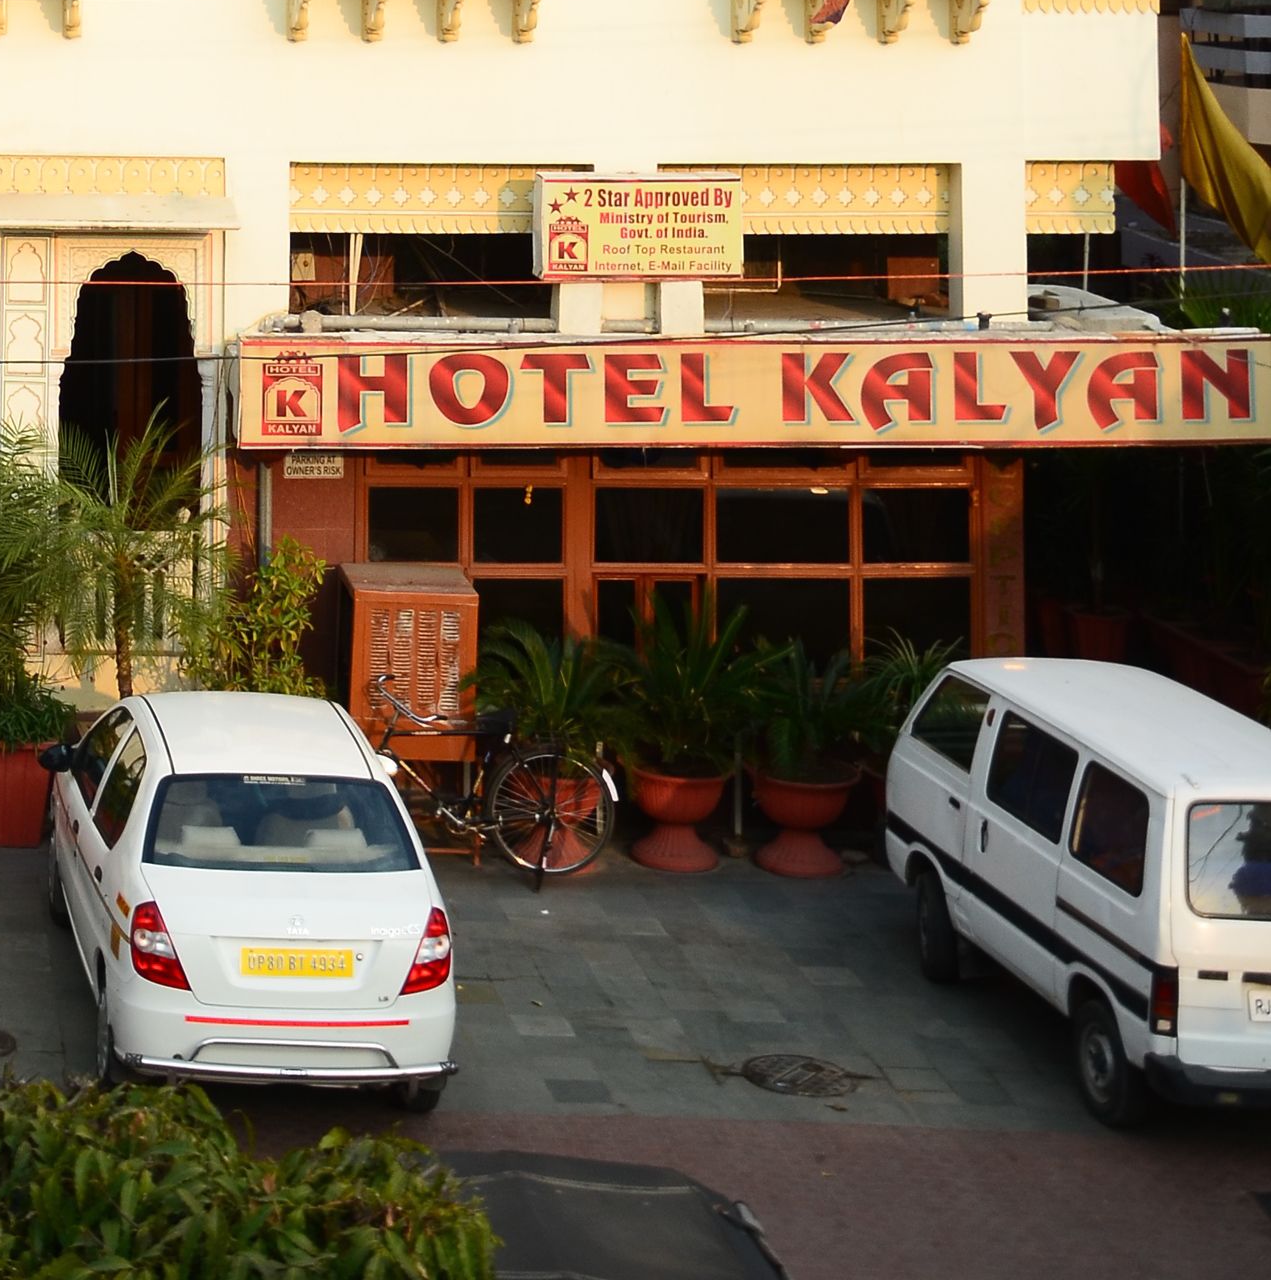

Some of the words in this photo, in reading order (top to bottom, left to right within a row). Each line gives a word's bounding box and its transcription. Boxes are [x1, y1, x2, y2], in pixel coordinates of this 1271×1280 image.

[583, 188, 593, 207] 2
[597, 188, 630, 207] Star
[634, 187, 709, 209] Approved
[713, 187, 732, 208] By
[599, 211, 653, 224] Ministry
[656, 211, 669, 223] of
[672, 211, 729, 224] Tourism,
[620, 226, 652, 239] Govt.
[656, 226, 668, 239] of
[671, 226, 708, 239] India.
[558, 241, 578, 259] K
[602, 243, 630, 255] Roof
[634, 244, 656, 257] Top
[659, 243, 725, 255] Restaurant
[551, 263, 585, 271] KALYAN
[594, 260, 645, 272] Internet,
[648, 260, 685, 271] E-Mail
[689, 260, 732, 273] Facility
[269, 365, 317, 375] HOTEL
[337, 353, 739, 434] HOTEL
[781, 348, 1254, 433] KALYAN
[276, 390, 307, 418] K
[268, 423, 317, 434] KALYAN
[291, 455, 325, 465] PARKING
[327, 455, 337, 465] AT
[286, 465, 321, 476] OWNER'S
[323, 466, 341, 476] RISK
